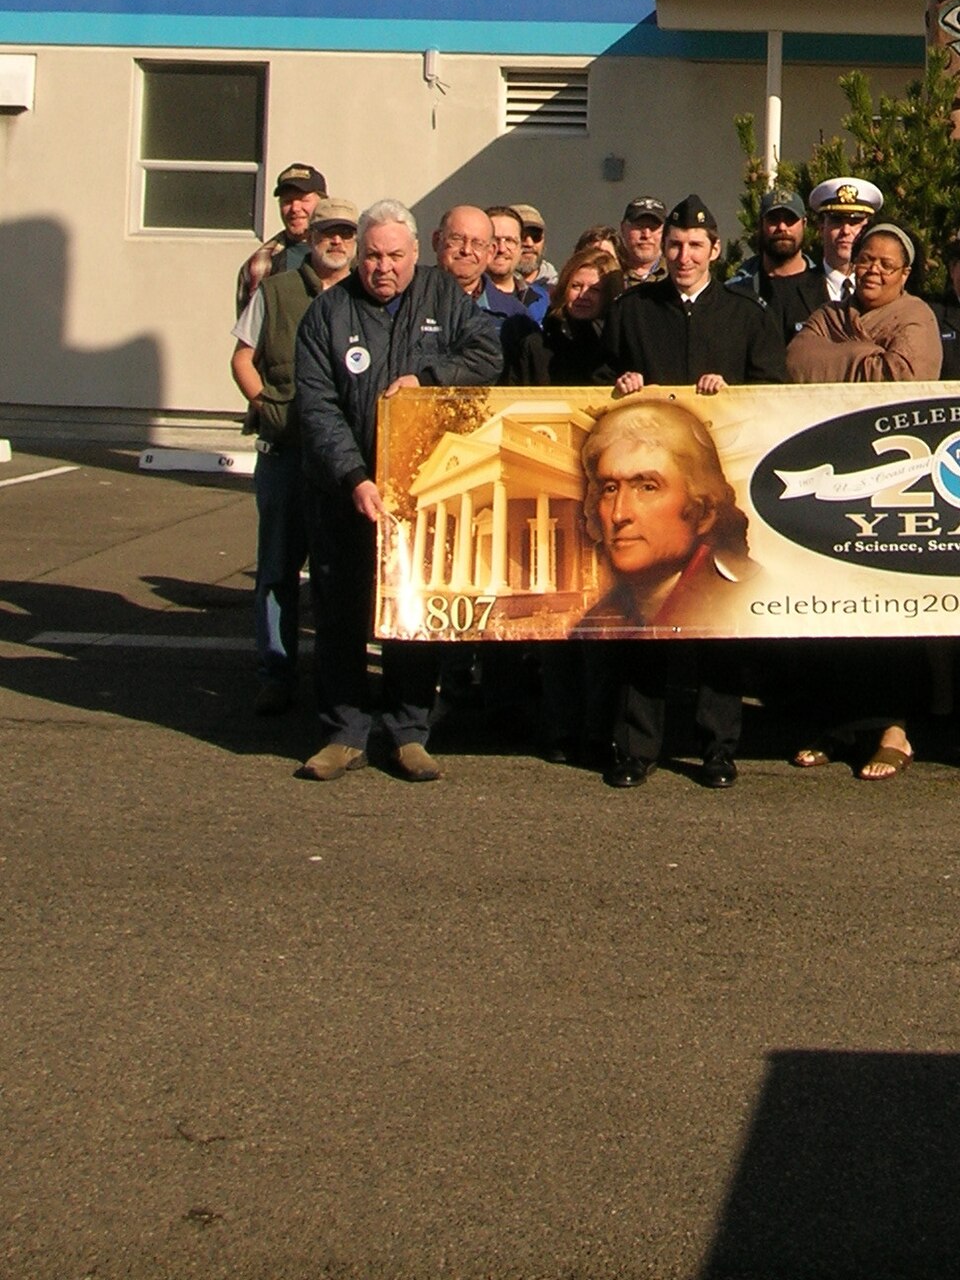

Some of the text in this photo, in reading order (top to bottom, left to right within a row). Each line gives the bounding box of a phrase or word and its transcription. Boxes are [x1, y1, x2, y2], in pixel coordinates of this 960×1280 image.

[833, 541, 852, 553] of
[855, 540, 923, 554] Science,
[408, 595, 497, 632] 807
